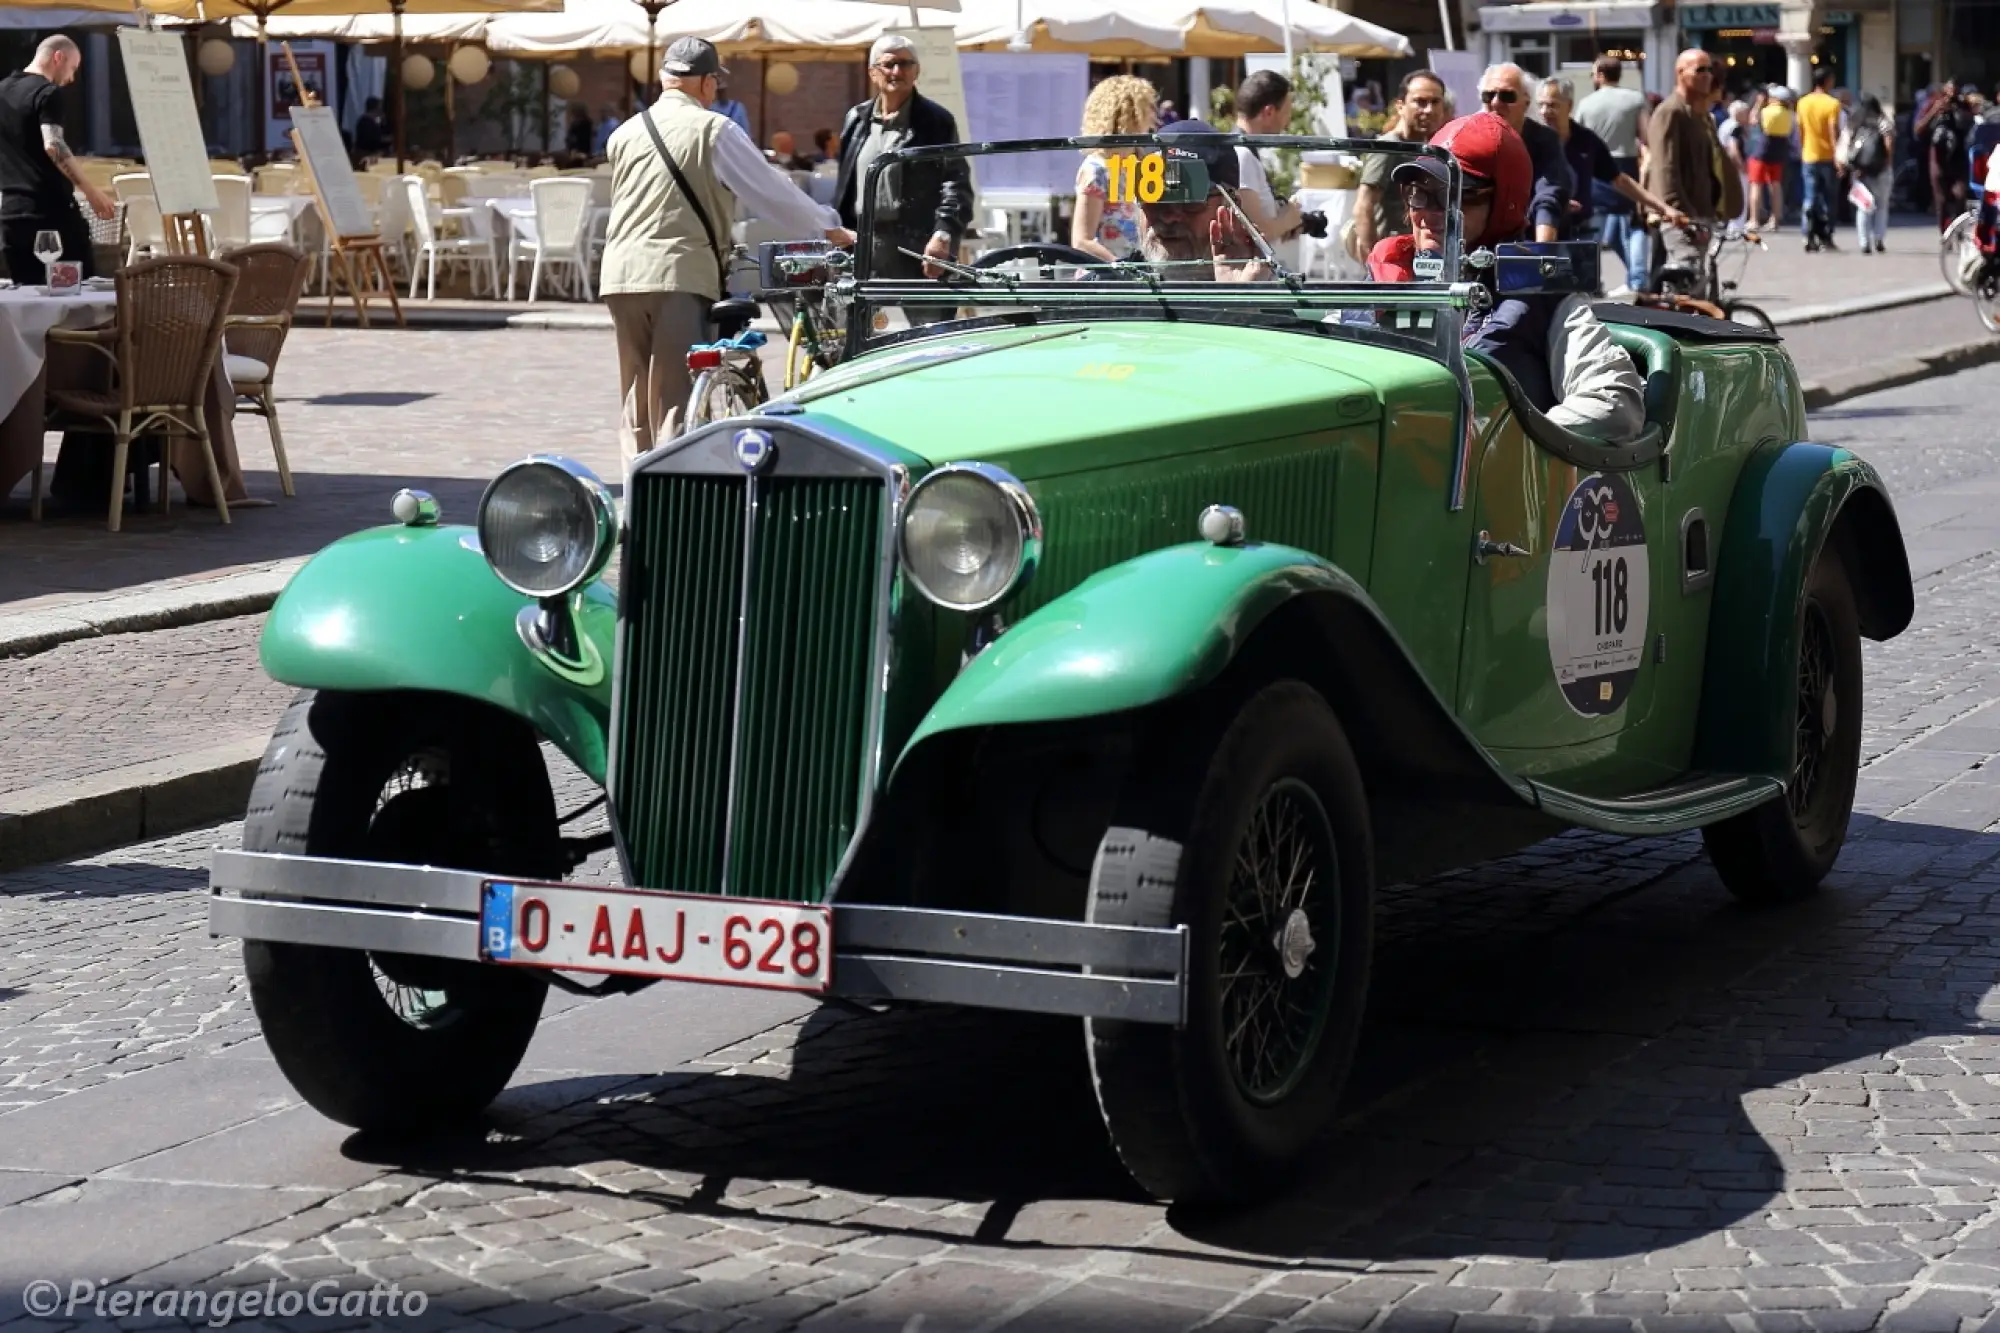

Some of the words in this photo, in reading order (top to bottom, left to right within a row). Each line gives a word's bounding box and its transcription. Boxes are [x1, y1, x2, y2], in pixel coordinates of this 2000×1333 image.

[1105, 153, 1165, 204] 118
[1592, 557, 1628, 635] 118
[488, 925, 506, 953] B
